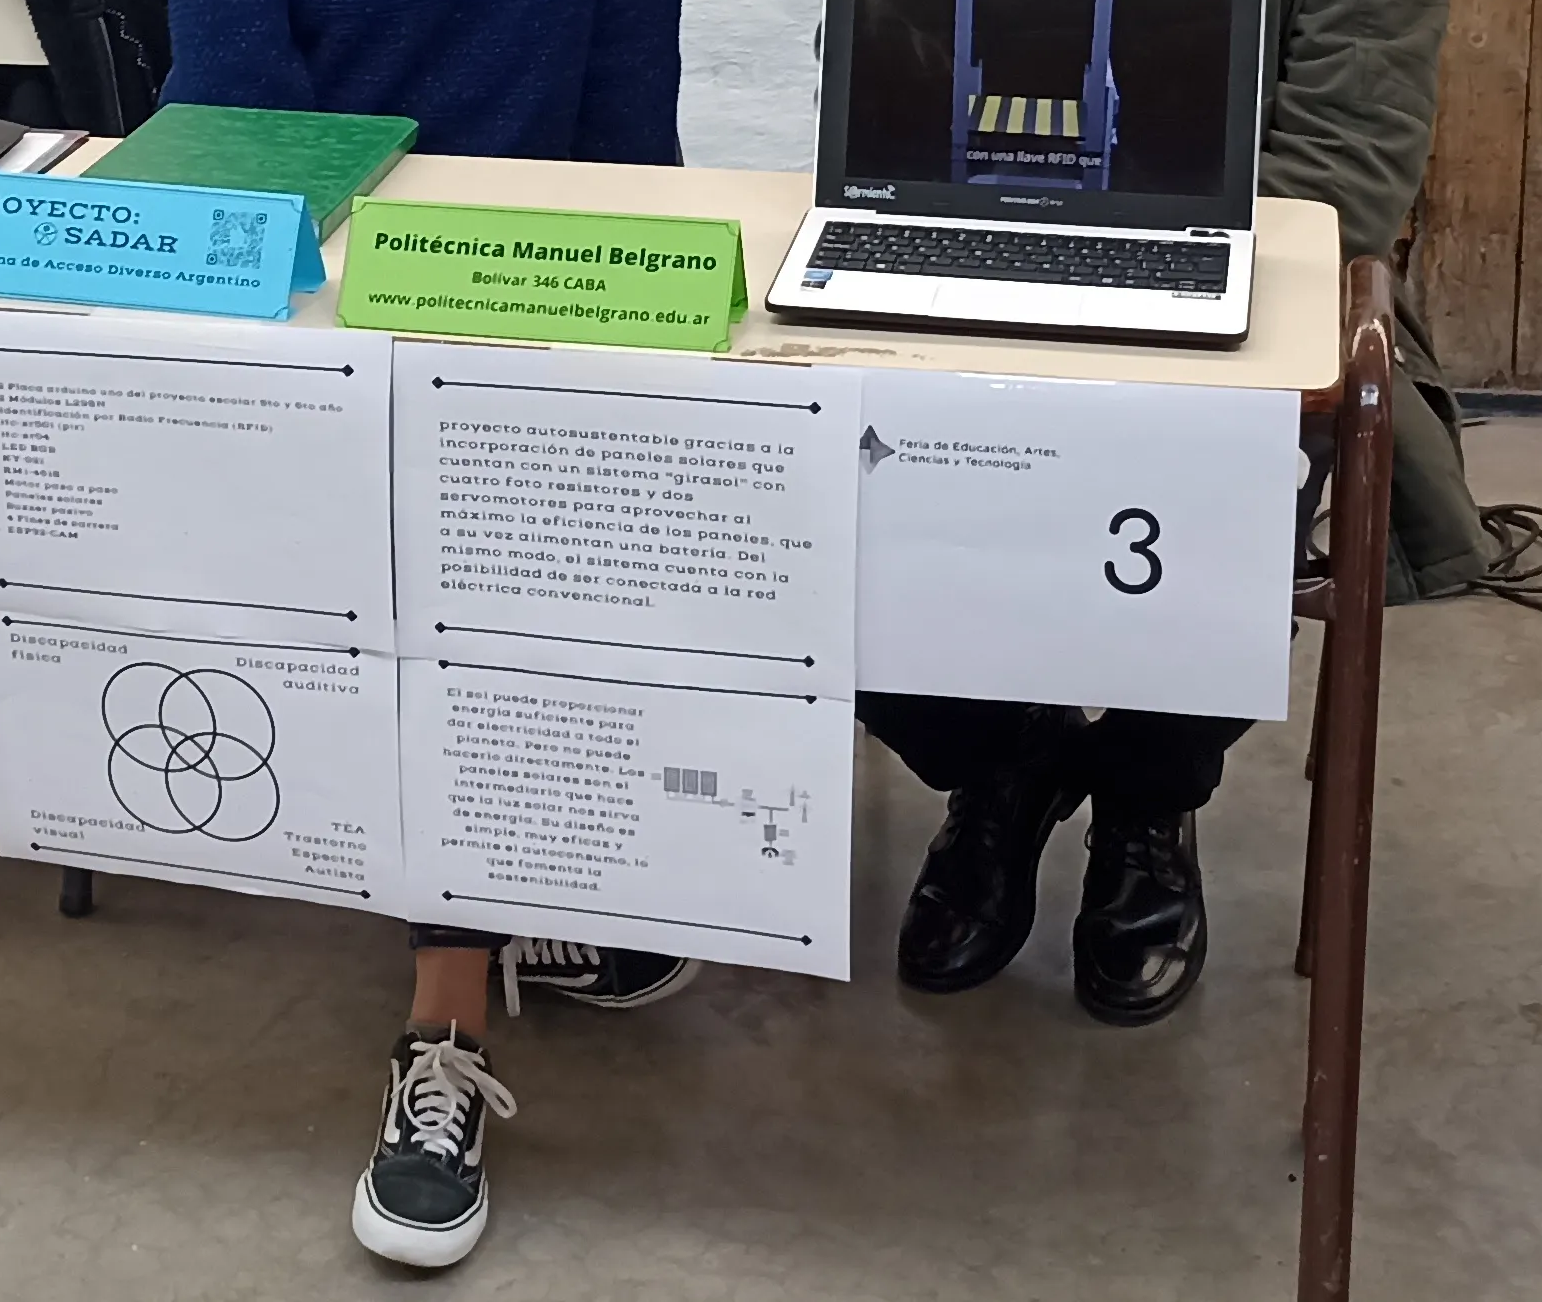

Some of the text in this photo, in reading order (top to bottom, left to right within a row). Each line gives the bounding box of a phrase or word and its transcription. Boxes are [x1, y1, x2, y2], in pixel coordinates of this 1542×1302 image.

[64, 226, 178, 254] SADAR
[374, 232, 717, 271] Politécnica Manuel Belgrano
[20, 256, 40, 268] de
[43, 259, 103, 274] Acceso
[107, 264, 172, 280] Diverso
[175, 271, 260, 288] Argentino
[471, 270, 606, 292] Bolívar 346 CABA
[368, 293, 710, 325] www.politecnicamanuelbelgrano.edu.ar
[439, 421, 794, 455] proyecto autosustentable gracias a la
[898, 438, 930, 451] Feria
[933, 441, 949, 451] de
[439, 437, 785, 475] incorporación de paneles solares que
[898, 452, 950, 465] Ciencias
[953, 458, 960, 466] y
[438, 456, 515, 469] cuentan
[520, 461, 553, 472] con
[558, 465, 580, 474] un
[586, 466, 659, 481] sistema
[752, 480, 785, 492] con
[439, 474, 694, 502] cuatro foto resistores y dos
[439, 492, 751, 525] servomotores para aprovechar al
[440, 509, 515, 523] máximo
[520, 513, 537, 525] la
[541, 515, 633, 533] eficiencia
[638, 523, 660, 535] de
[666, 525, 692, 538] los
[779, 538, 812, 550] que
[439, 527, 450, 536] a
[456, 528, 477, 538] su
[483, 530, 513, 541] vez
[518, 532, 614, 549] alimentan
[618, 542, 653, 553] una
[737, 550, 765, 563] Del
[1104, 507, 1163, 595] 3
[441, 545, 502, 557] mismo
[565, 553, 581, 564] el
[586, 556, 659, 572] sistema
[664, 564, 728, 578] cuenta
[733, 570, 767, 581] con
[773, 571, 789, 583] la
[440, 578, 522, 595] eléctrica
[441, 563, 776, 600] posibilidad de ser conectada a la red
[9, 632, 128, 655] Discapacidad
[236, 657, 360, 676] Discapacidad
[282, 679, 359, 695] auditiva
[30, 809, 147, 833] Discapacidad
[32, 826, 85, 840] visual
[330, 821, 365, 835] TEA
[282, 830, 367, 851] Trastorno
[291, 847, 364, 867] Espectro
[304, 864, 365, 881] Autista
